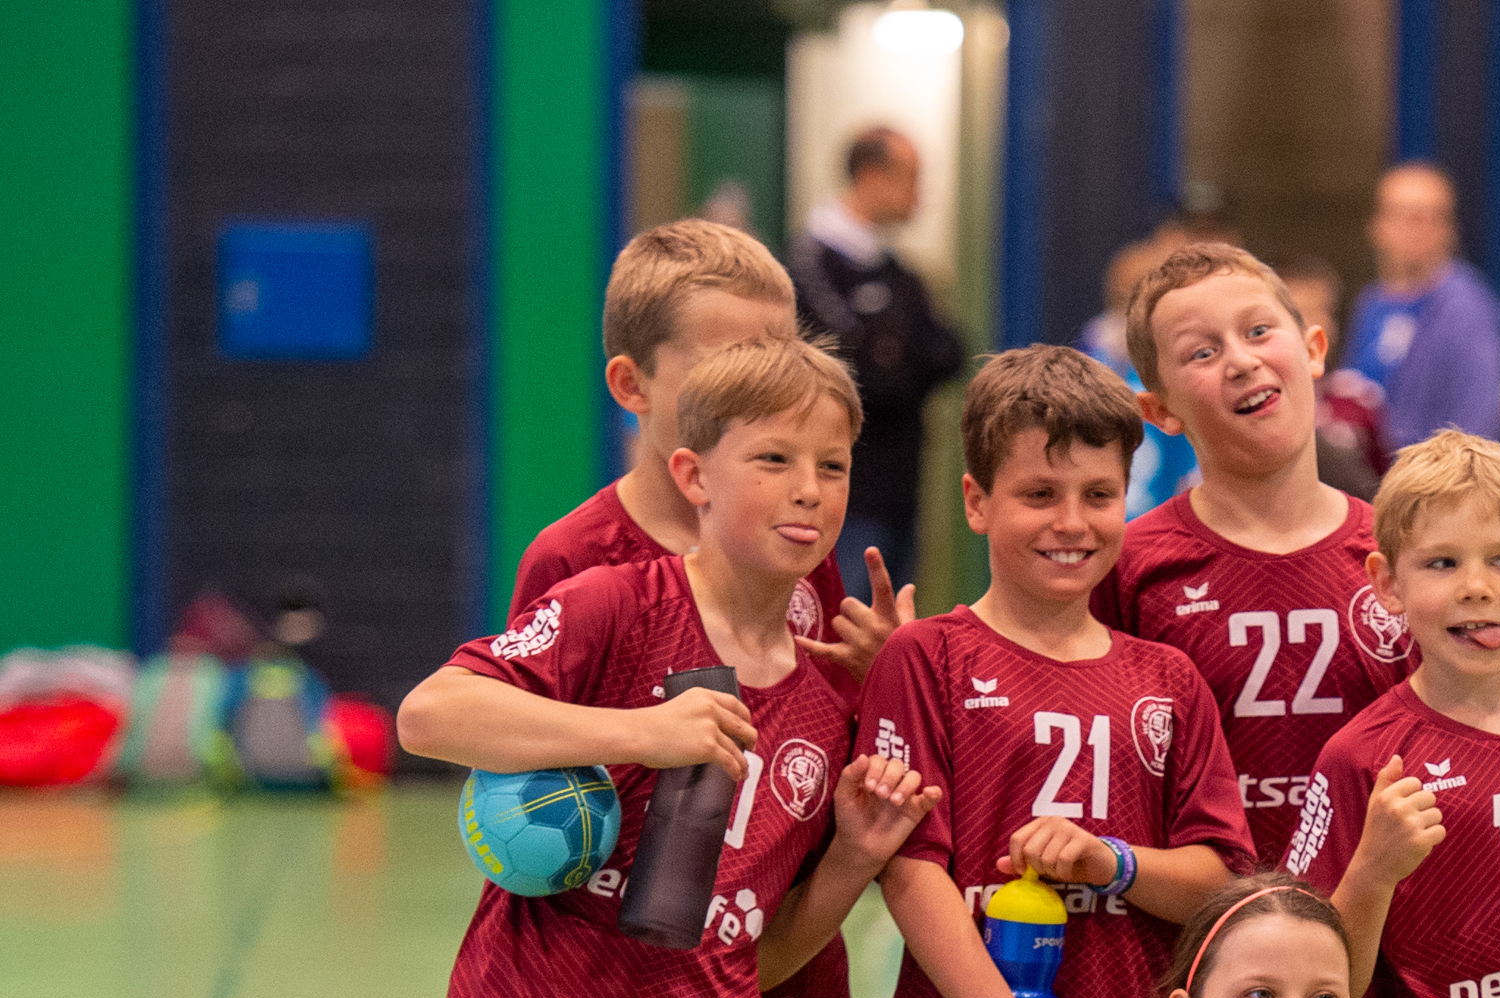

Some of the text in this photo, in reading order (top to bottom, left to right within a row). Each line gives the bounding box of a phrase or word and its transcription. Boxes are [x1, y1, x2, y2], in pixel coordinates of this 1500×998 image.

[1175, 597, 1221, 616] erima
[1229, 609, 1343, 717] 22
[964, 695, 1010, 710] erima
[1031, 711, 1111, 820] 21
[1422, 775, 1467, 792] erima
